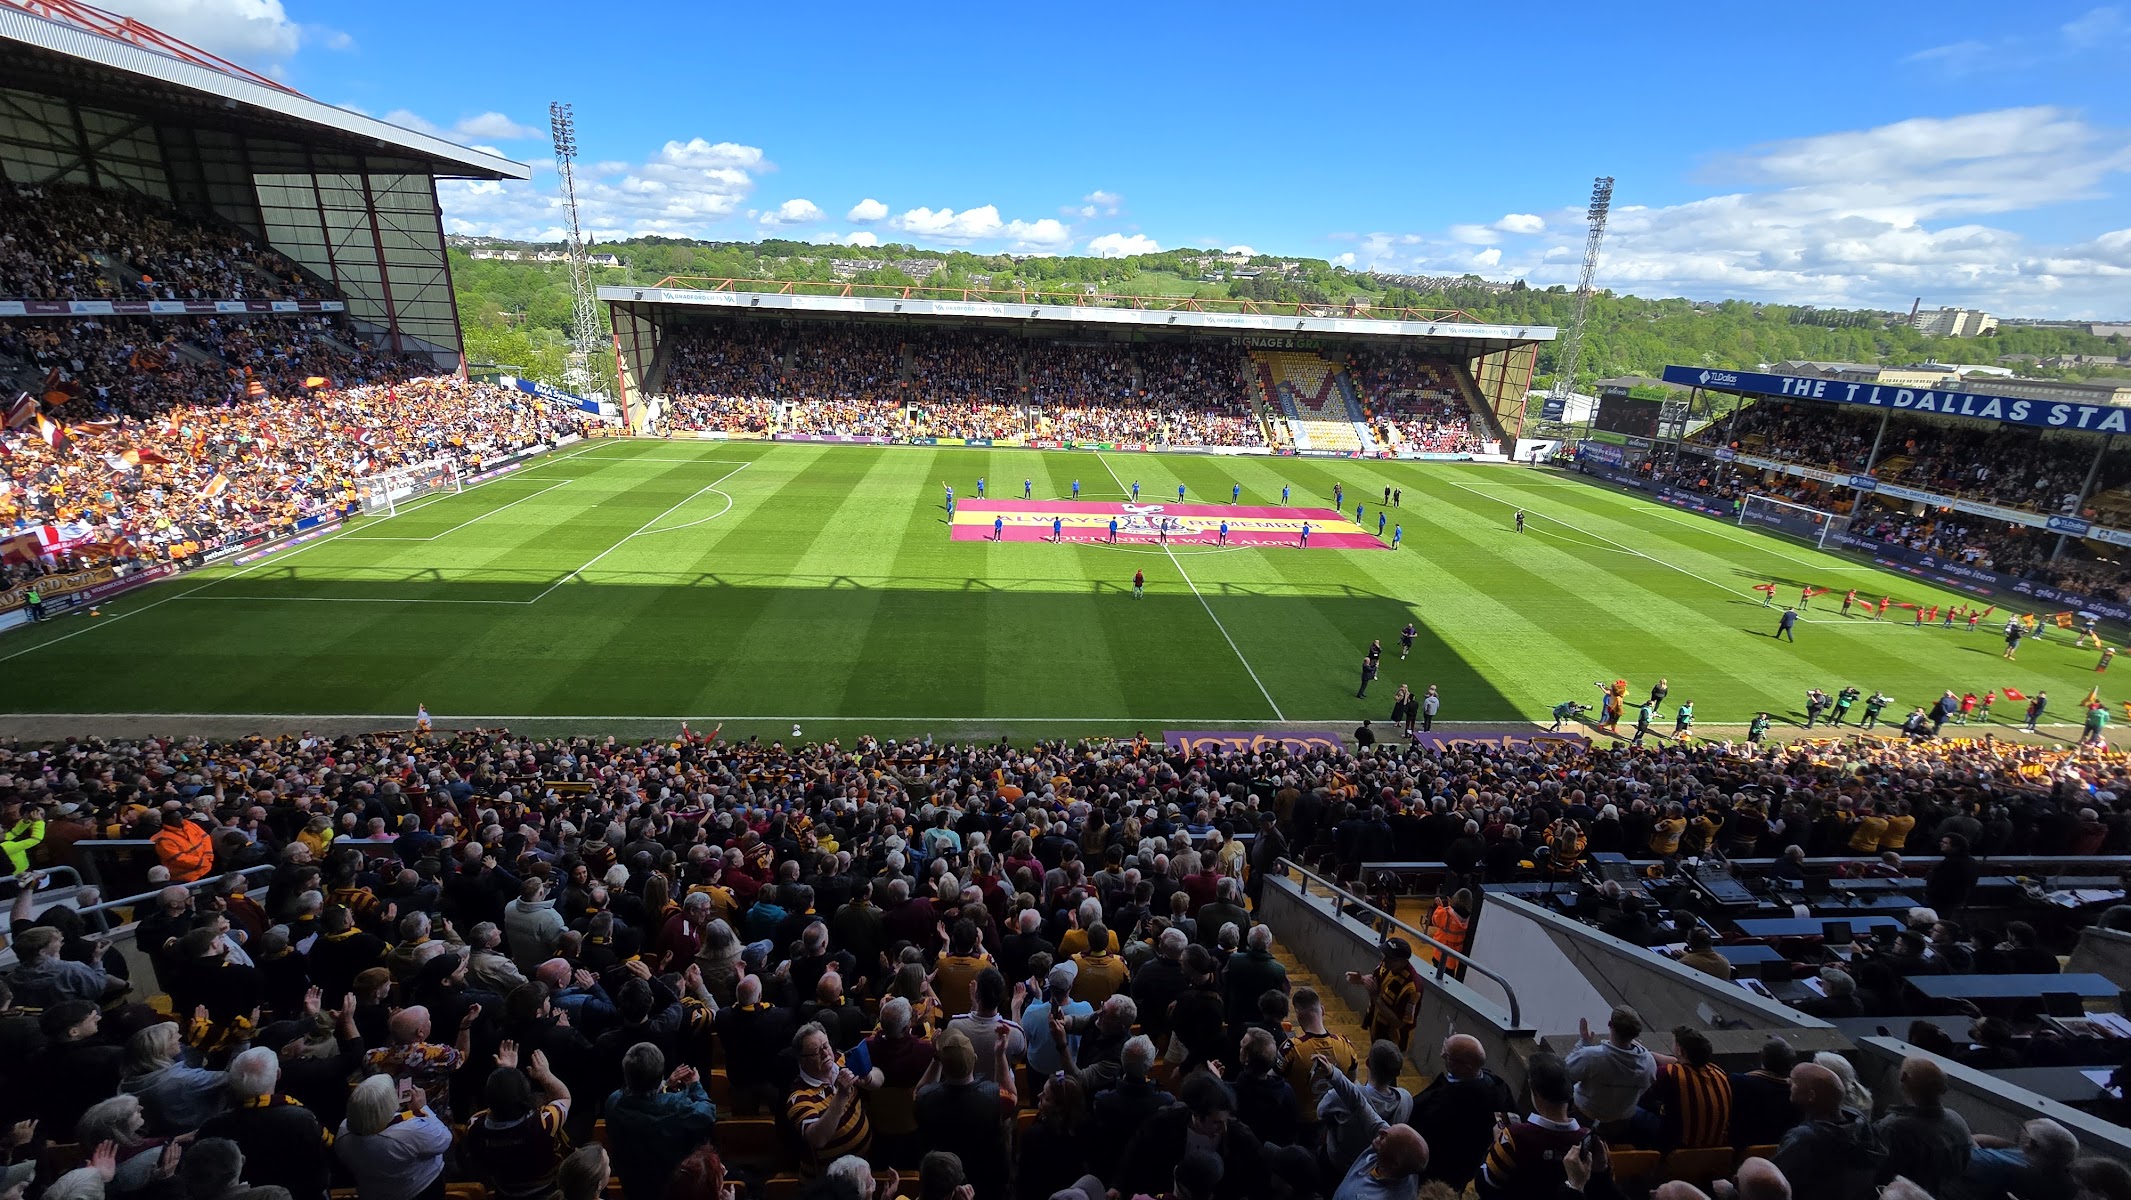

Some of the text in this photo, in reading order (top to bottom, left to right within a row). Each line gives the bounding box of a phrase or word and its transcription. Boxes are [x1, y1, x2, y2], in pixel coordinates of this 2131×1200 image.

[1231, 337, 1283, 348] SIGNAGE
[1285, 339, 1294, 348] &
[534, 384, 583, 406] RMA Systems
[1782, 377, 1827, 397] THE
[1847, 384, 1860, 401] T
[1868, 386, 1882, 405] L
[1893, 389, 2032, 421] DALLAS
[2047, 405, 2127, 432] STA
[1802, 469, 1836, 481] COLLETT
[1877, 484, 1908, 495] THOMPSON,
[1909, 491, 1925, 499] DAVIS
[1000, 515, 1323, 529] ALWAYS REMEMBER
[1744, 510, 1763, 520] single
[1832, 532, 1855, 545] single
[90, 566, 163, 594] WOODHOUSE GROVE SCHOOL
[1942, 563, 1972, 576] single
[1972, 569, 1996, 583] item
[2064, 595, 2083, 607] sin
[2087, 602, 2127, 618] single
